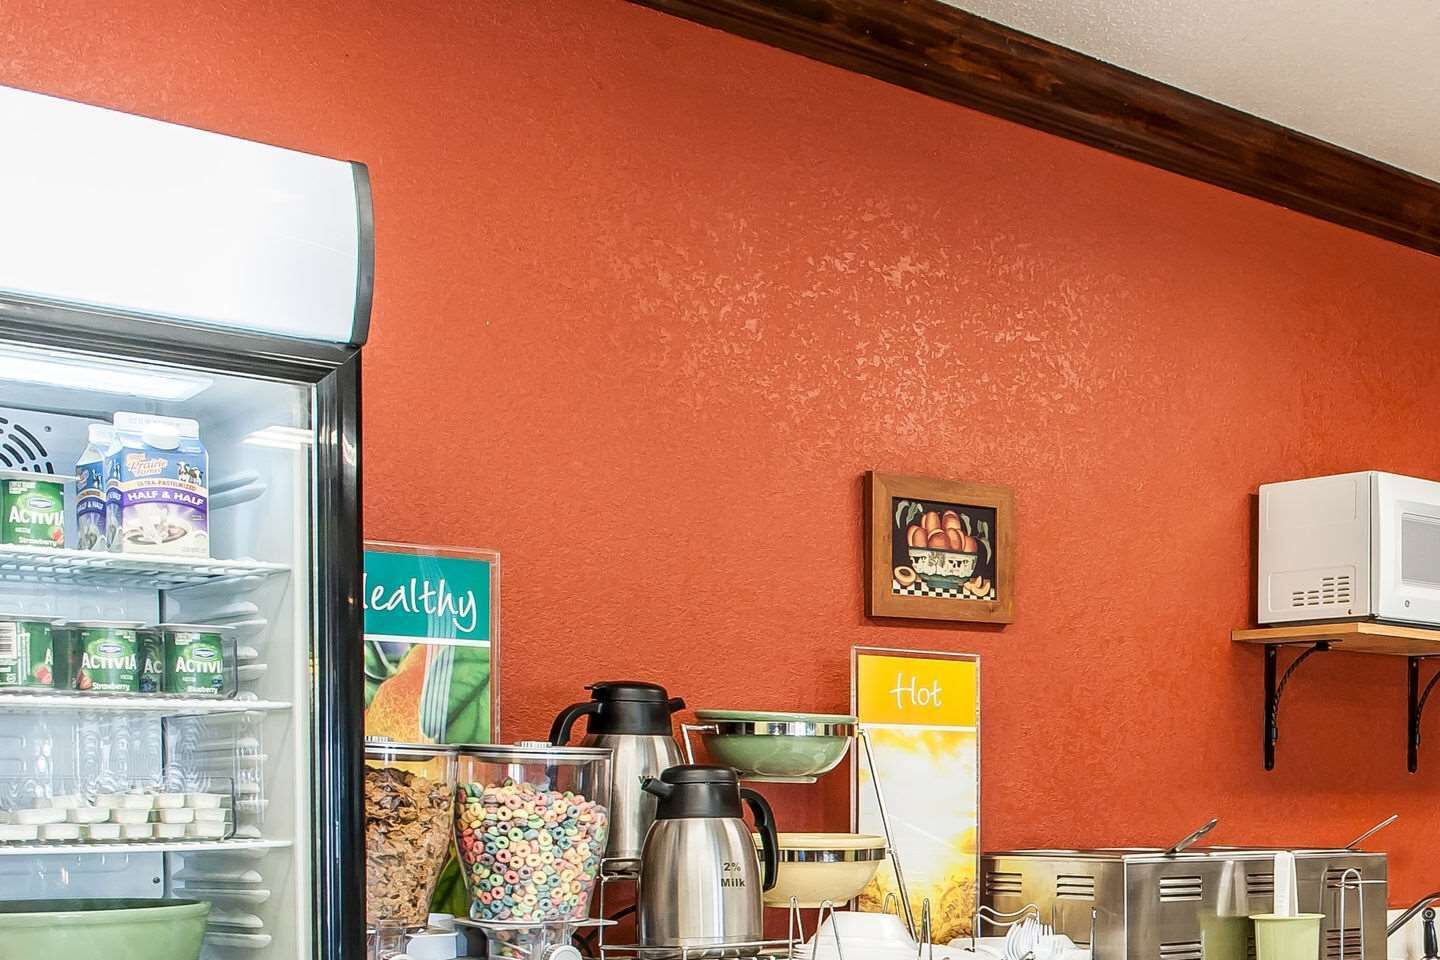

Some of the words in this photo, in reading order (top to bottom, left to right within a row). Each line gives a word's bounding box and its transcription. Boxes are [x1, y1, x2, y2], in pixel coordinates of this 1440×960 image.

[128, 491, 158, 501] HALF
[162, 491, 171, 499] &
[174, 492, 204, 506] HALF
[364, 573, 478, 633] ealthy
[82, 652, 137, 670] ACTIVIA
[889, 671, 943, 710] Hot
[723, 862, 741, 872] 2%
[720, 878, 746, 888] Milk
